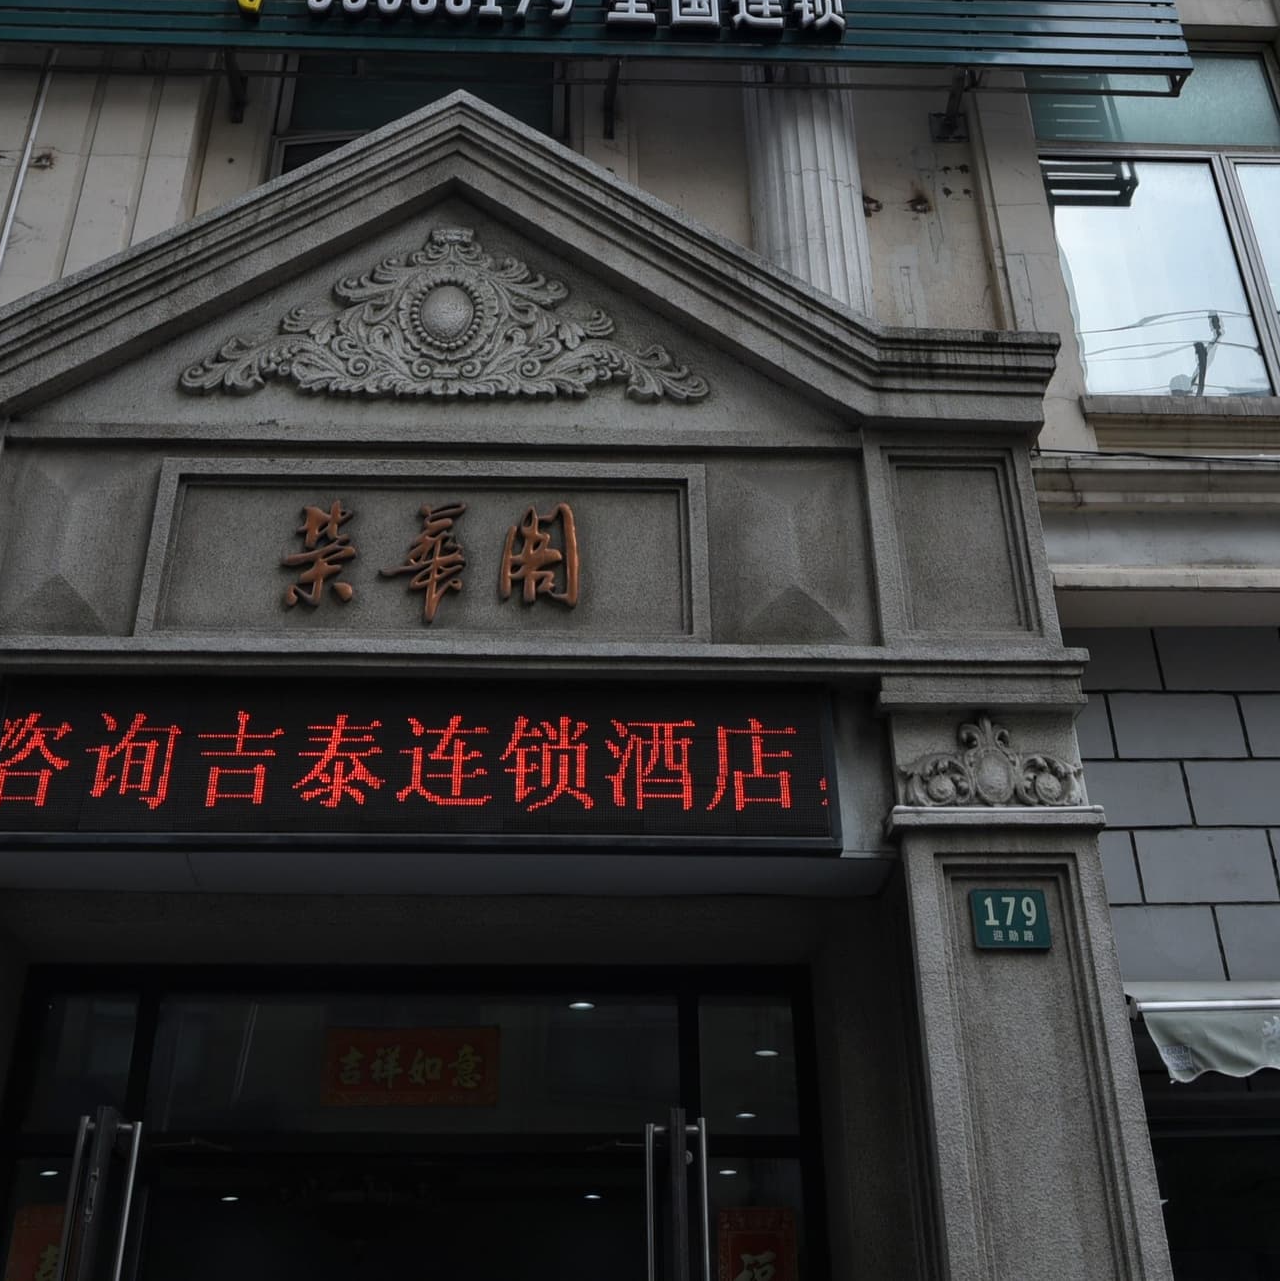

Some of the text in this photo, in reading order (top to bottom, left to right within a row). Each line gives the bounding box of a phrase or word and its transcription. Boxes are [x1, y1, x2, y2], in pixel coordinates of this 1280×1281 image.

[983, 896, 1037, 926] 179
[338, 1043, 485, 1091] 吉祥如意
